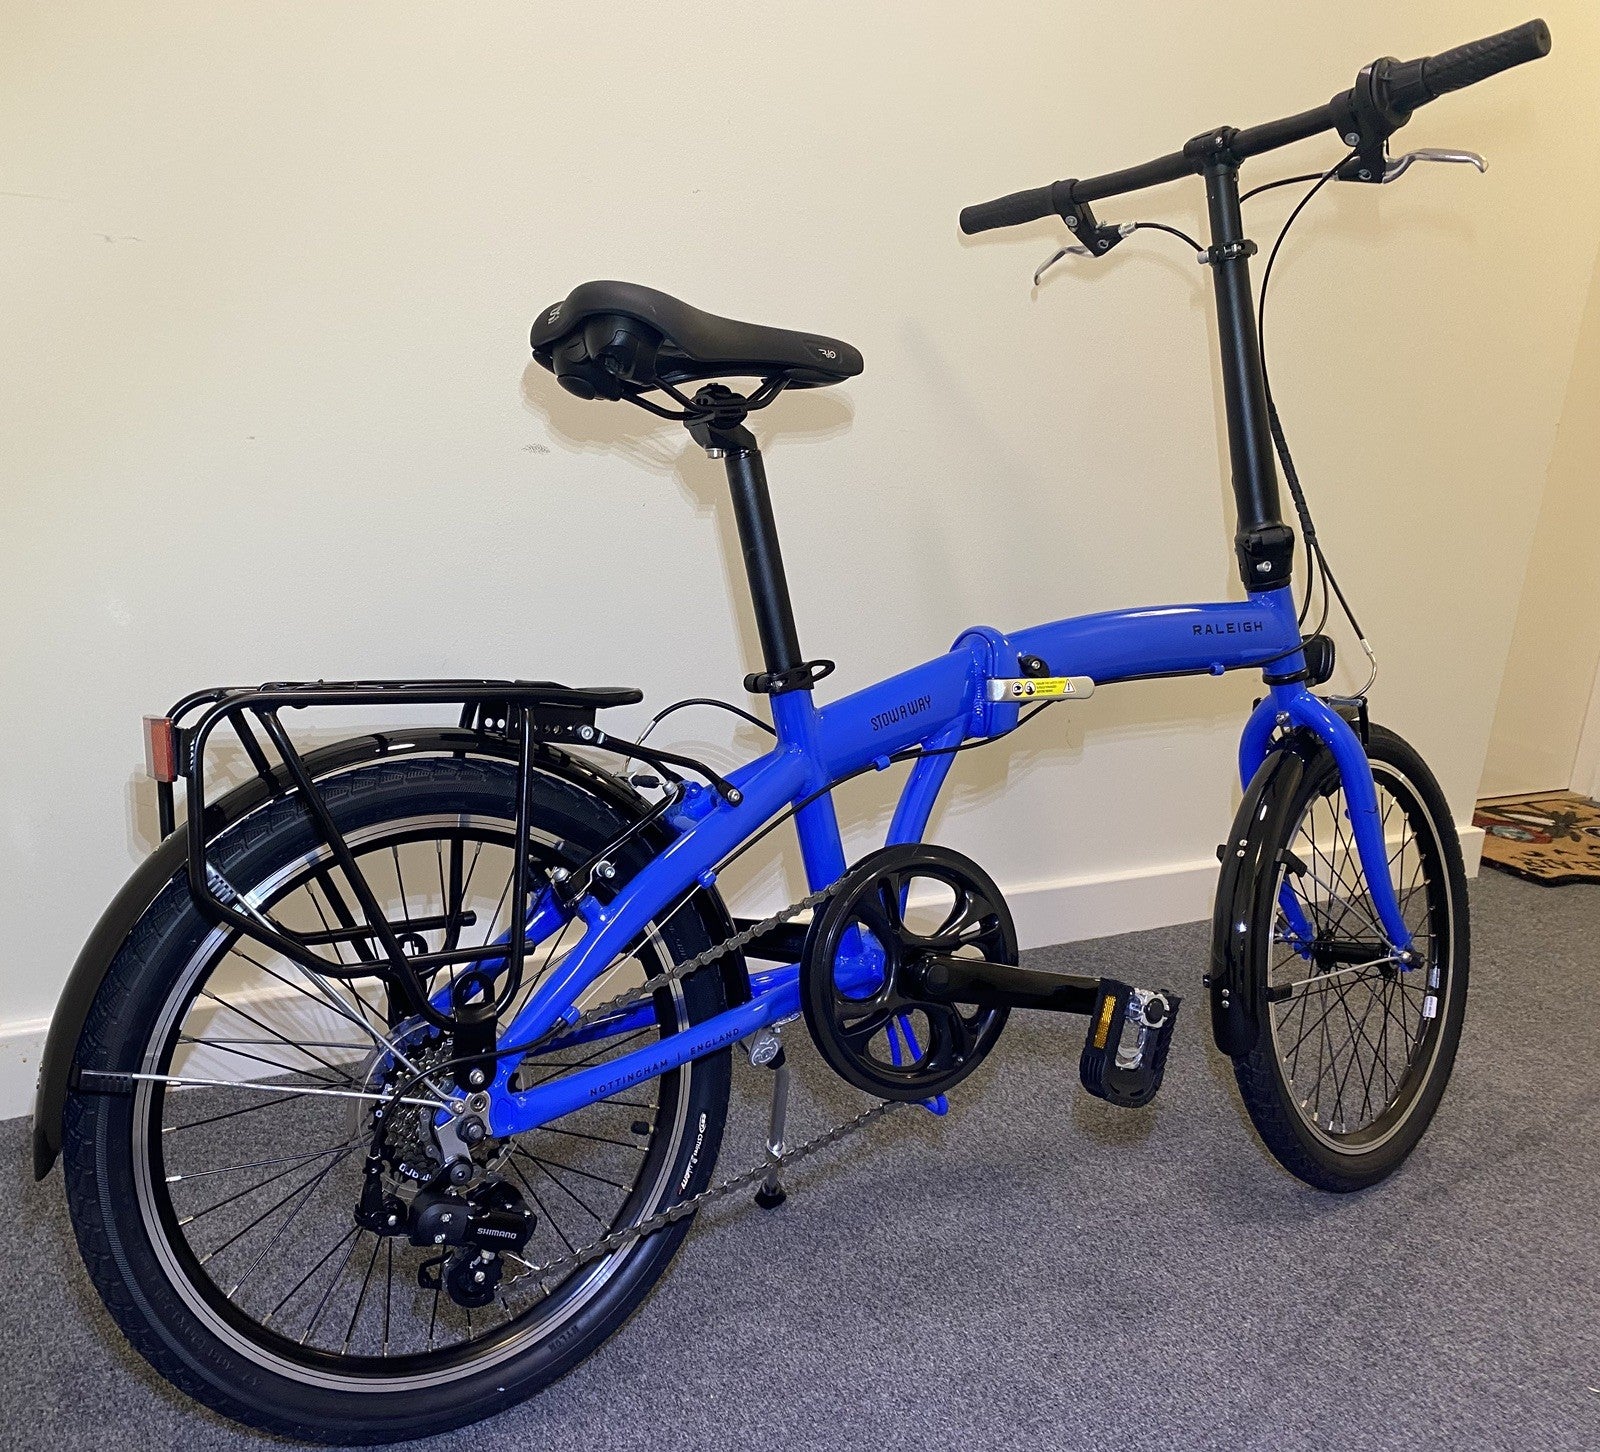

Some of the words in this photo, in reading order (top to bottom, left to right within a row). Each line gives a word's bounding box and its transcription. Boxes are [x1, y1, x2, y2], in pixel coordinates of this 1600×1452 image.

[1192, 621, 1263, 636] RALEIGH
[590, 1059, 668, 1097] NOTTINGHAM
[690, 1028, 740, 1056] ENGLAND
[477, 1227, 517, 1240] SHIMANO
